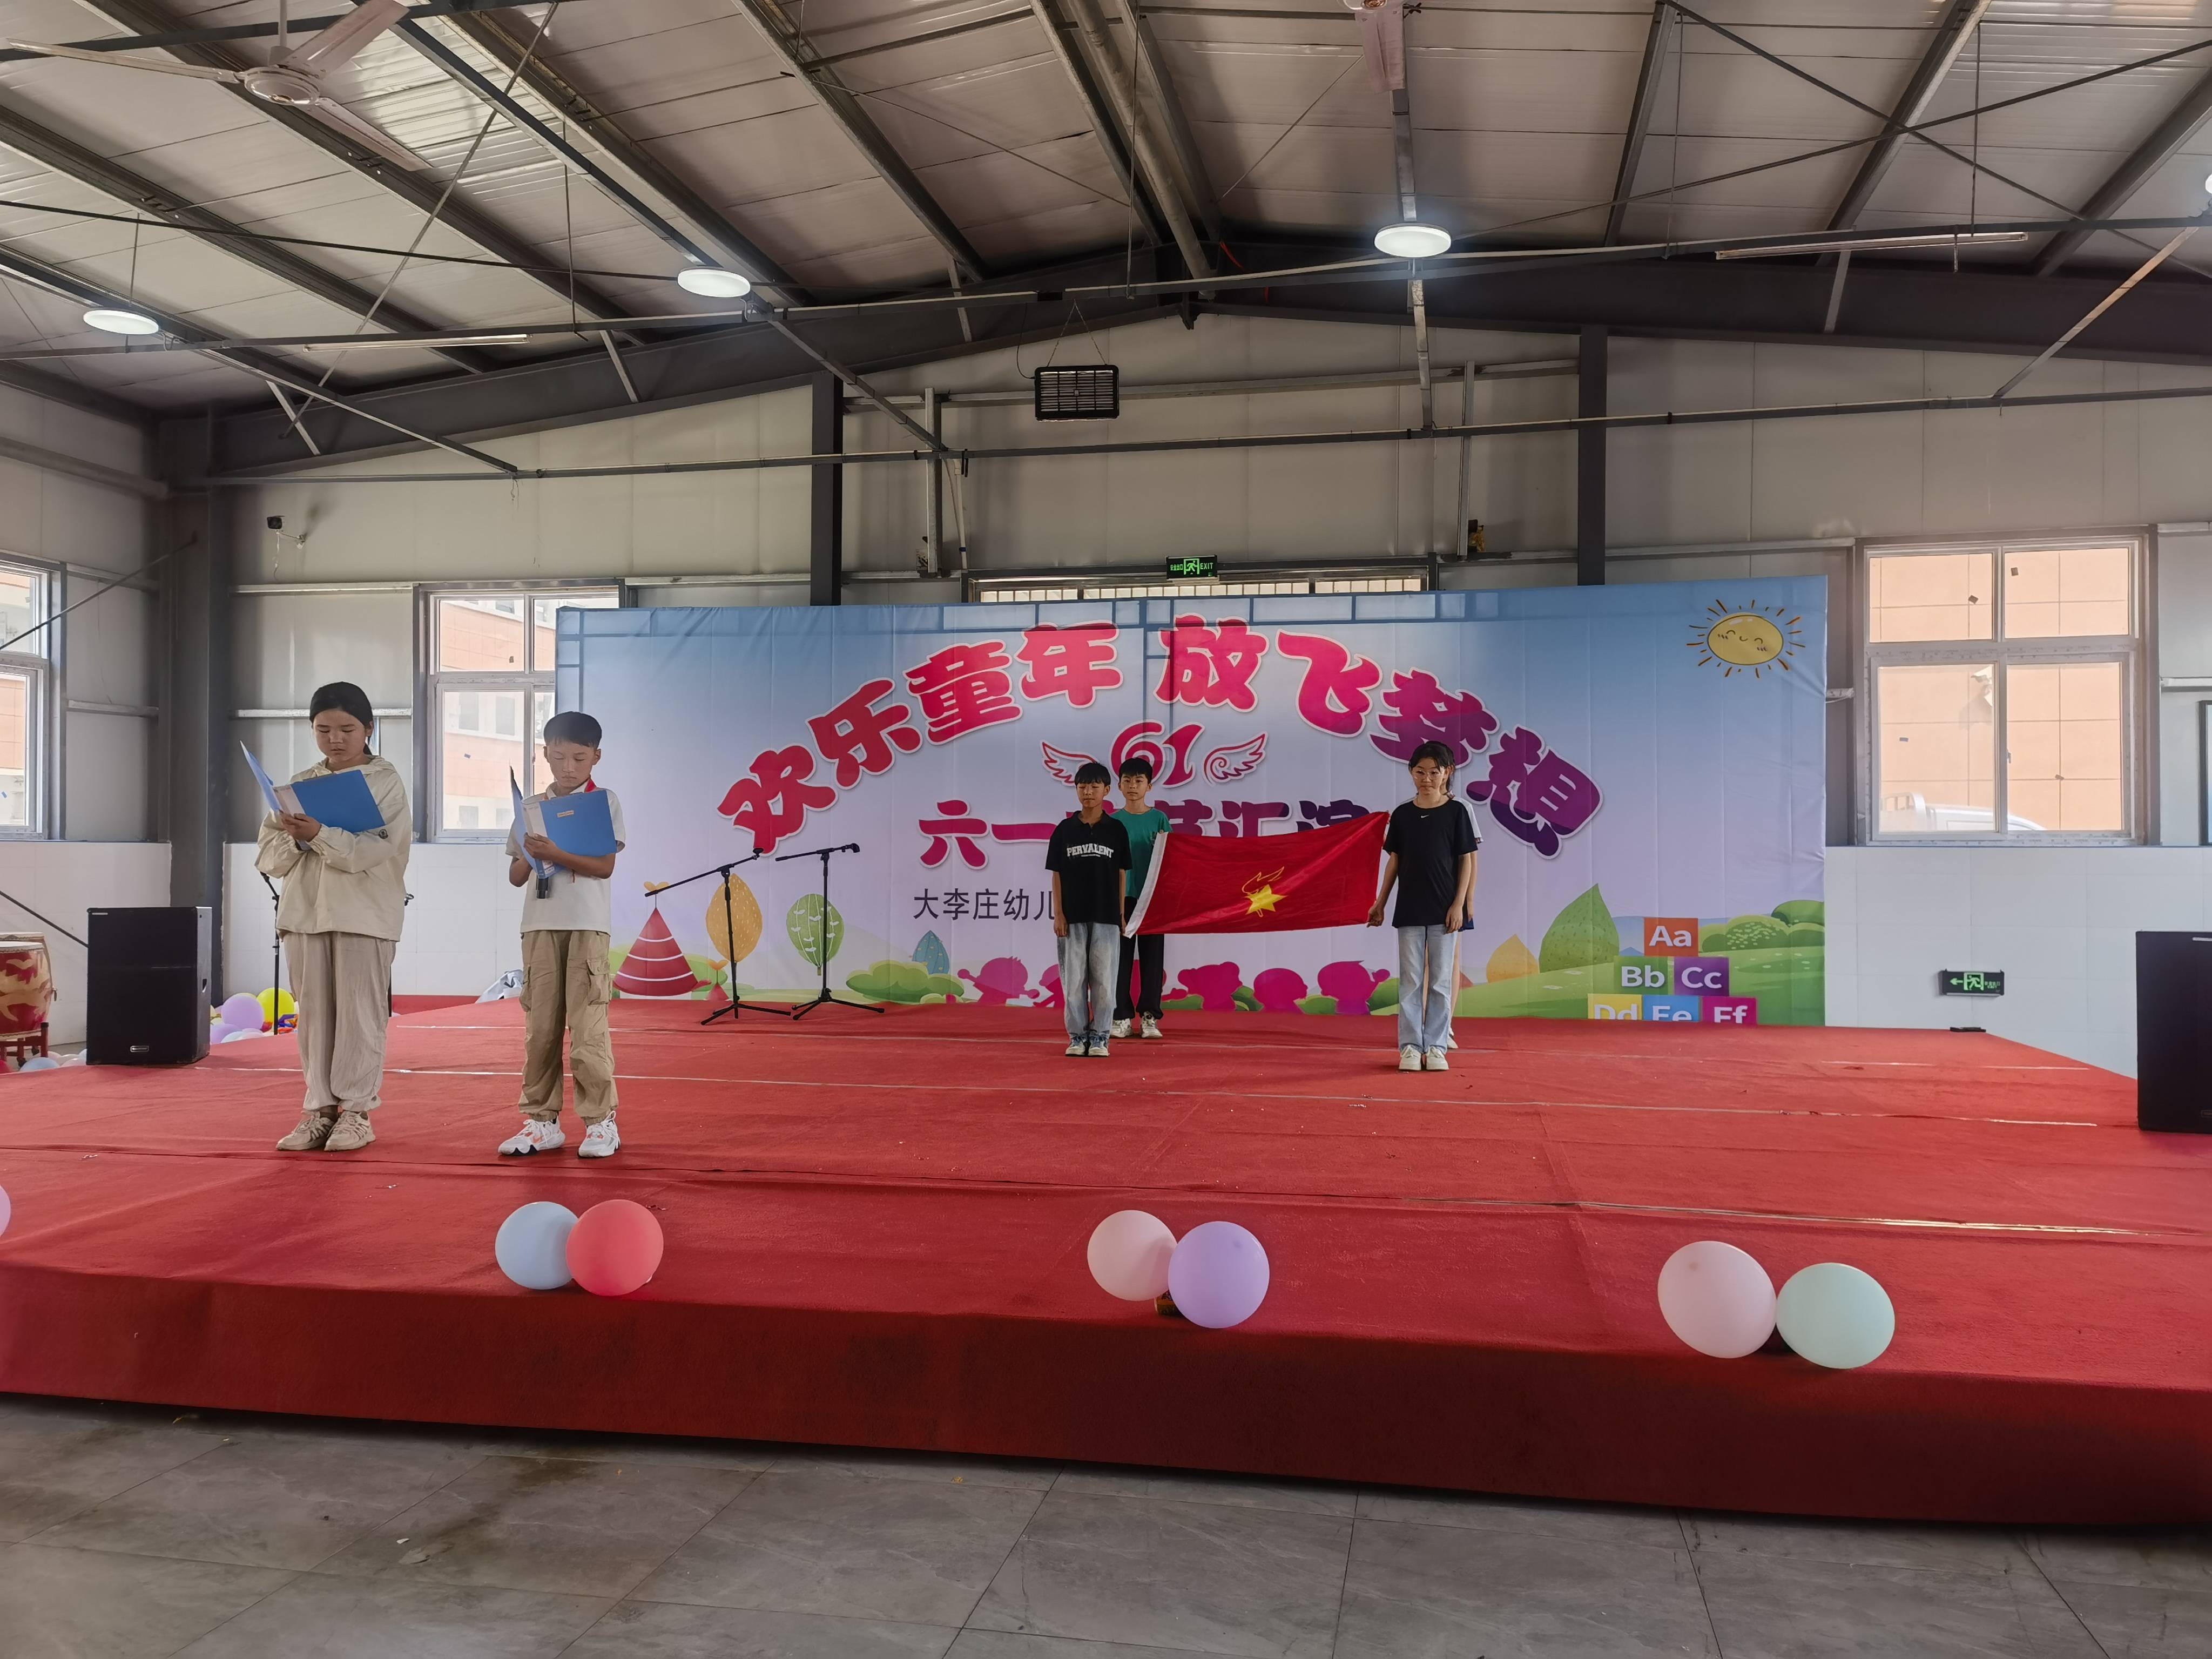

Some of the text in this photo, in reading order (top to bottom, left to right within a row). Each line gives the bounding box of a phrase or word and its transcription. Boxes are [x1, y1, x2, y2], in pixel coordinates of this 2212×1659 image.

[717, 613, 1604, 860] 欢乐童年 放飞梦想
[1110, 720, 1205, 788] 61
[1066, 843, 1114, 858] PERVALENT
[1649, 925, 1692, 947] Aa
[1621, 965, 1723, 989] Bb Cc
[1594, 1003, 1748, 1023] Dd Ee Ff
